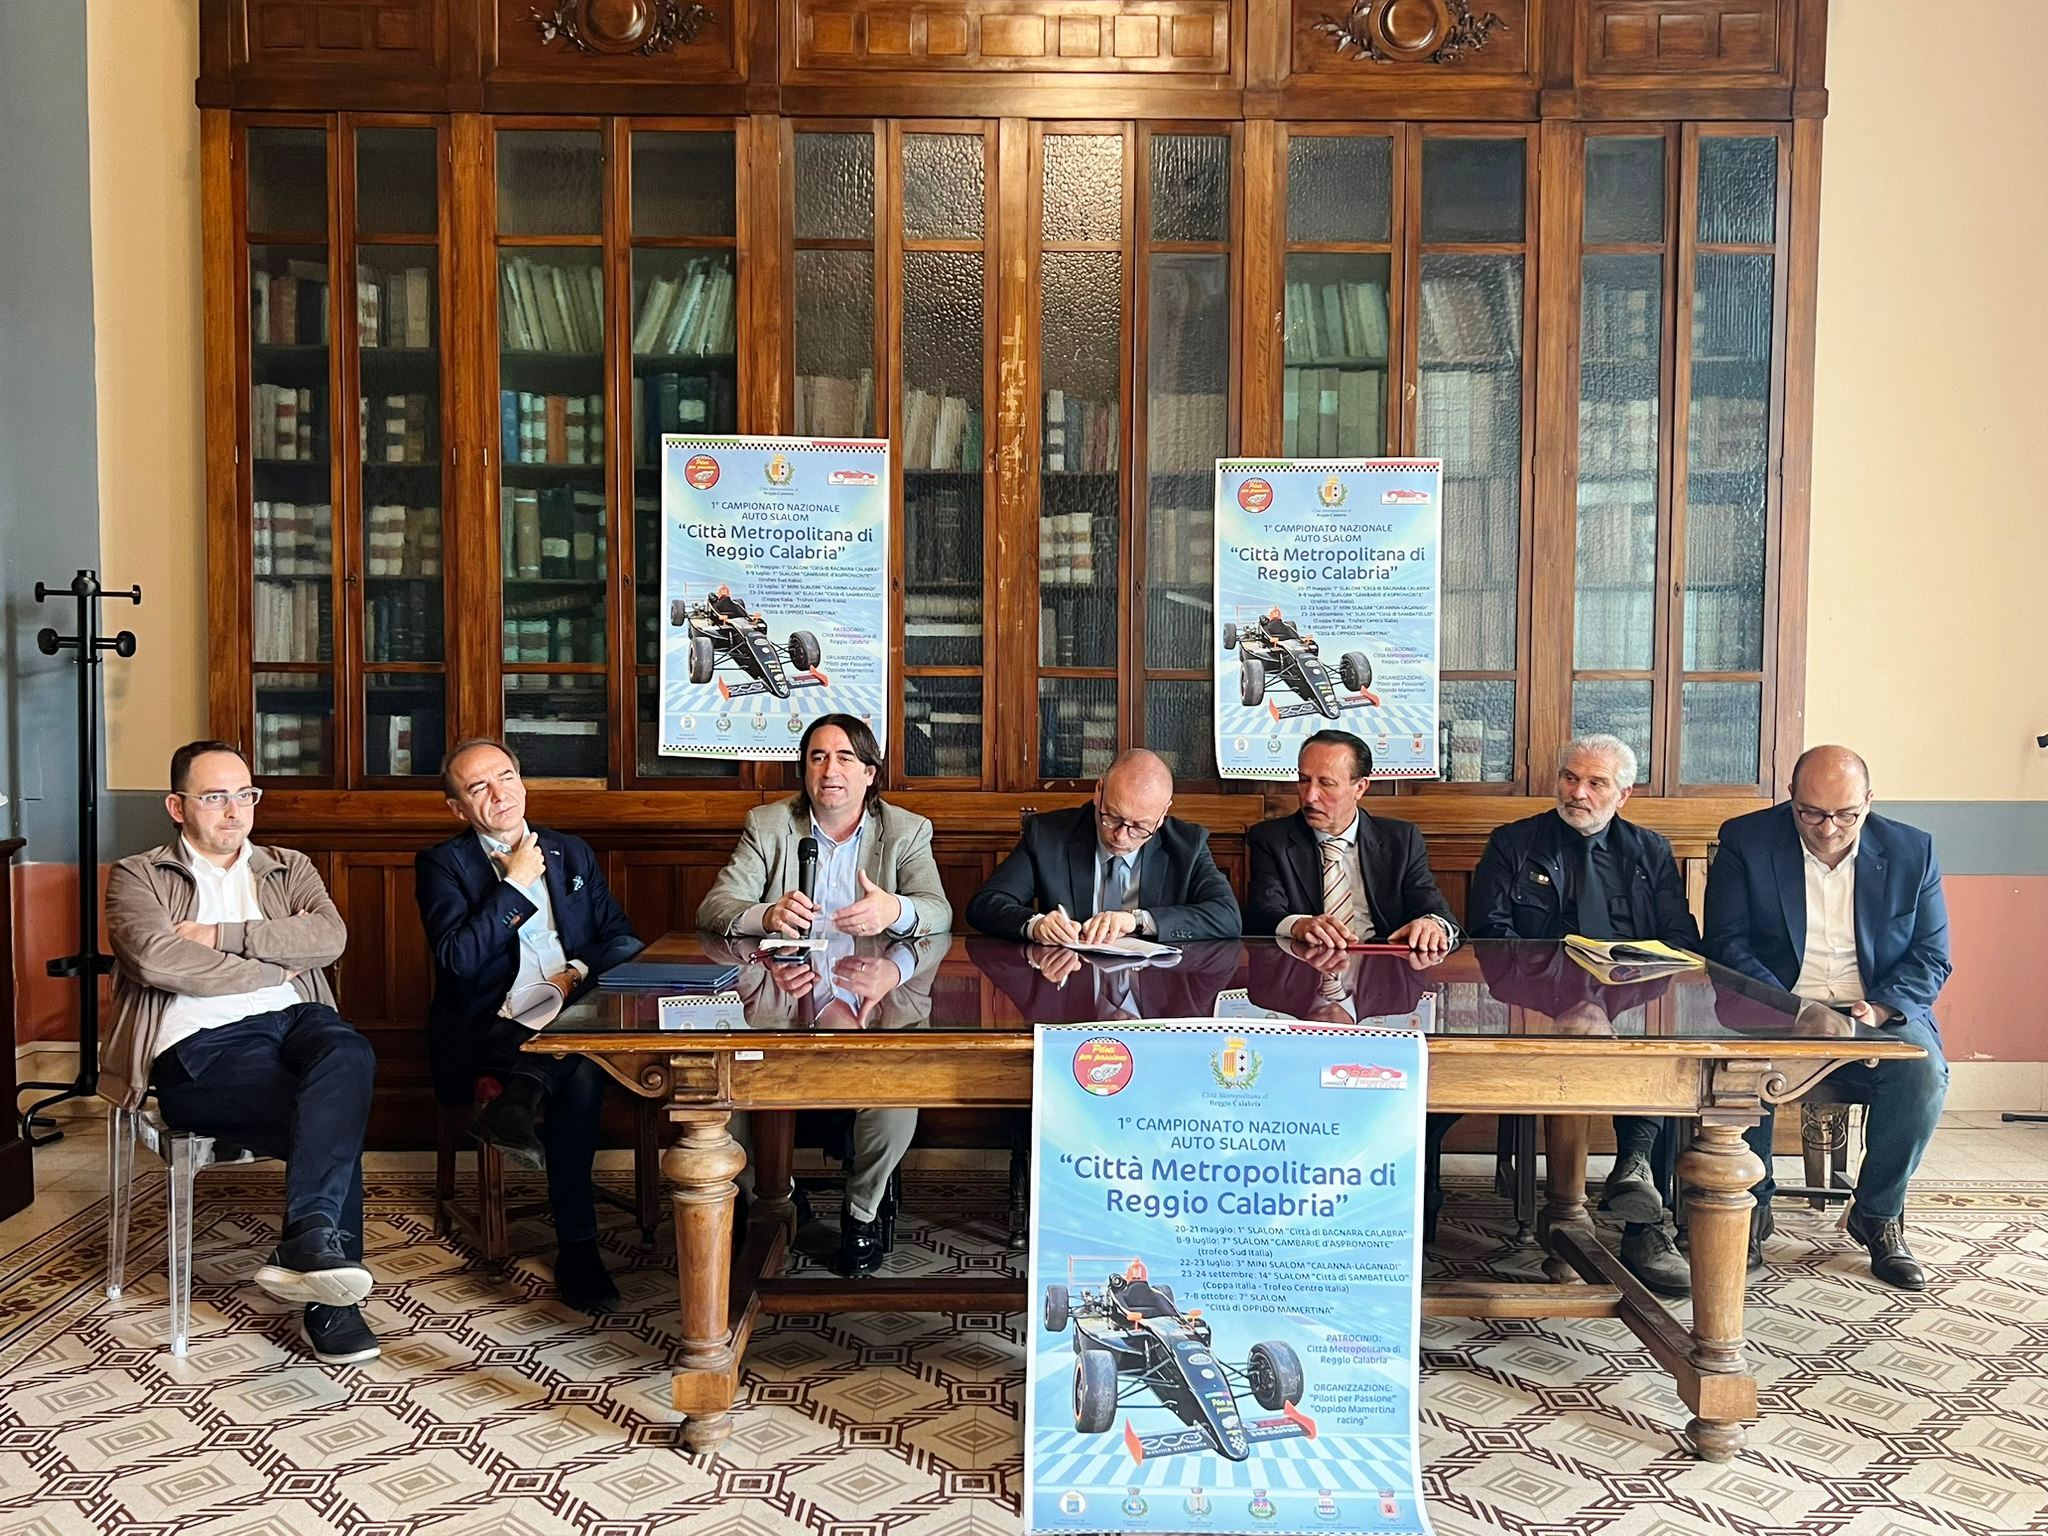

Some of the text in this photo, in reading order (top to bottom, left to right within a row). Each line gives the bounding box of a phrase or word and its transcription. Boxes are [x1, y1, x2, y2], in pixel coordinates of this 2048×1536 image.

[722, 502, 784, 511] CAMPIONATO
[787, 504, 840, 512] NAZIONALE
[742, 512, 809, 521] AUTO SLALOM
[1274, 525, 1337, 533] CAMPIONATO
[731, 526, 852, 543] Metropolitana
[858, 528, 872, 542] di
[706, 543, 764, 560] Reggio
[1284, 548, 1405, 566] Metropolitana
[1410, 547, 1424, 561] di
[1258, 566, 1316, 582] Reggio
[1209, 1099, 1230, 1108] Reggio
[1136, 1118, 1244, 1134] CAMPIONATO
[1249, 1121, 1340, 1135] NAZIONALE
[1171, 1137, 1286, 1152] AUTO SLALOM
[1152, 1159, 1362, 1189] Metropolitana
[1370, 1162, 1396, 1186] di
[1106, 1188, 1208, 1219] Reggio
[1201, 1226, 1236, 1236] maggio:
[1248, 1227, 1283, 1235] SLALOM
[1312, 1228, 1320, 1236] di
[1323, 1229, 1363, 1237] BAGNARA
[1193, 1237, 1220, 1246] luglio:
[1233, 1238, 1269, 1246] SLALOM
[1207, 1259, 1234, 1268] luglio:
[1247, 1260, 1267, 1268] MINI
[1270, 1260, 1305, 1269] SLALOM
[1209, 1270, 1257, 1279] settembre:
[1274, 1272, 1310, 1280] SLALOM
[1339, 1273, 1347, 1281] di
[1203, 1281, 1233, 1290] (Coppa
[1264, 1282, 1292, 1291] Trofeo
[1294, 1284, 1324, 1292] Centro
[1185, 1292, 1199, 1300] 7-8
[1250, 1294, 1287, 1302] SLALOM
[1243, 1304, 1276, 1312] OPPIDO
[1326, 1335, 1382, 1343] PATROCINIO:
[1307, 1345, 1400, 1354] Città Metropolitana di
[1320, 1356, 1387, 1365] Reggio Calabria
[1314, 1384, 1392, 1392] ORGANIZZAZIONE:
[1338, 1396, 1353, 1404] per
